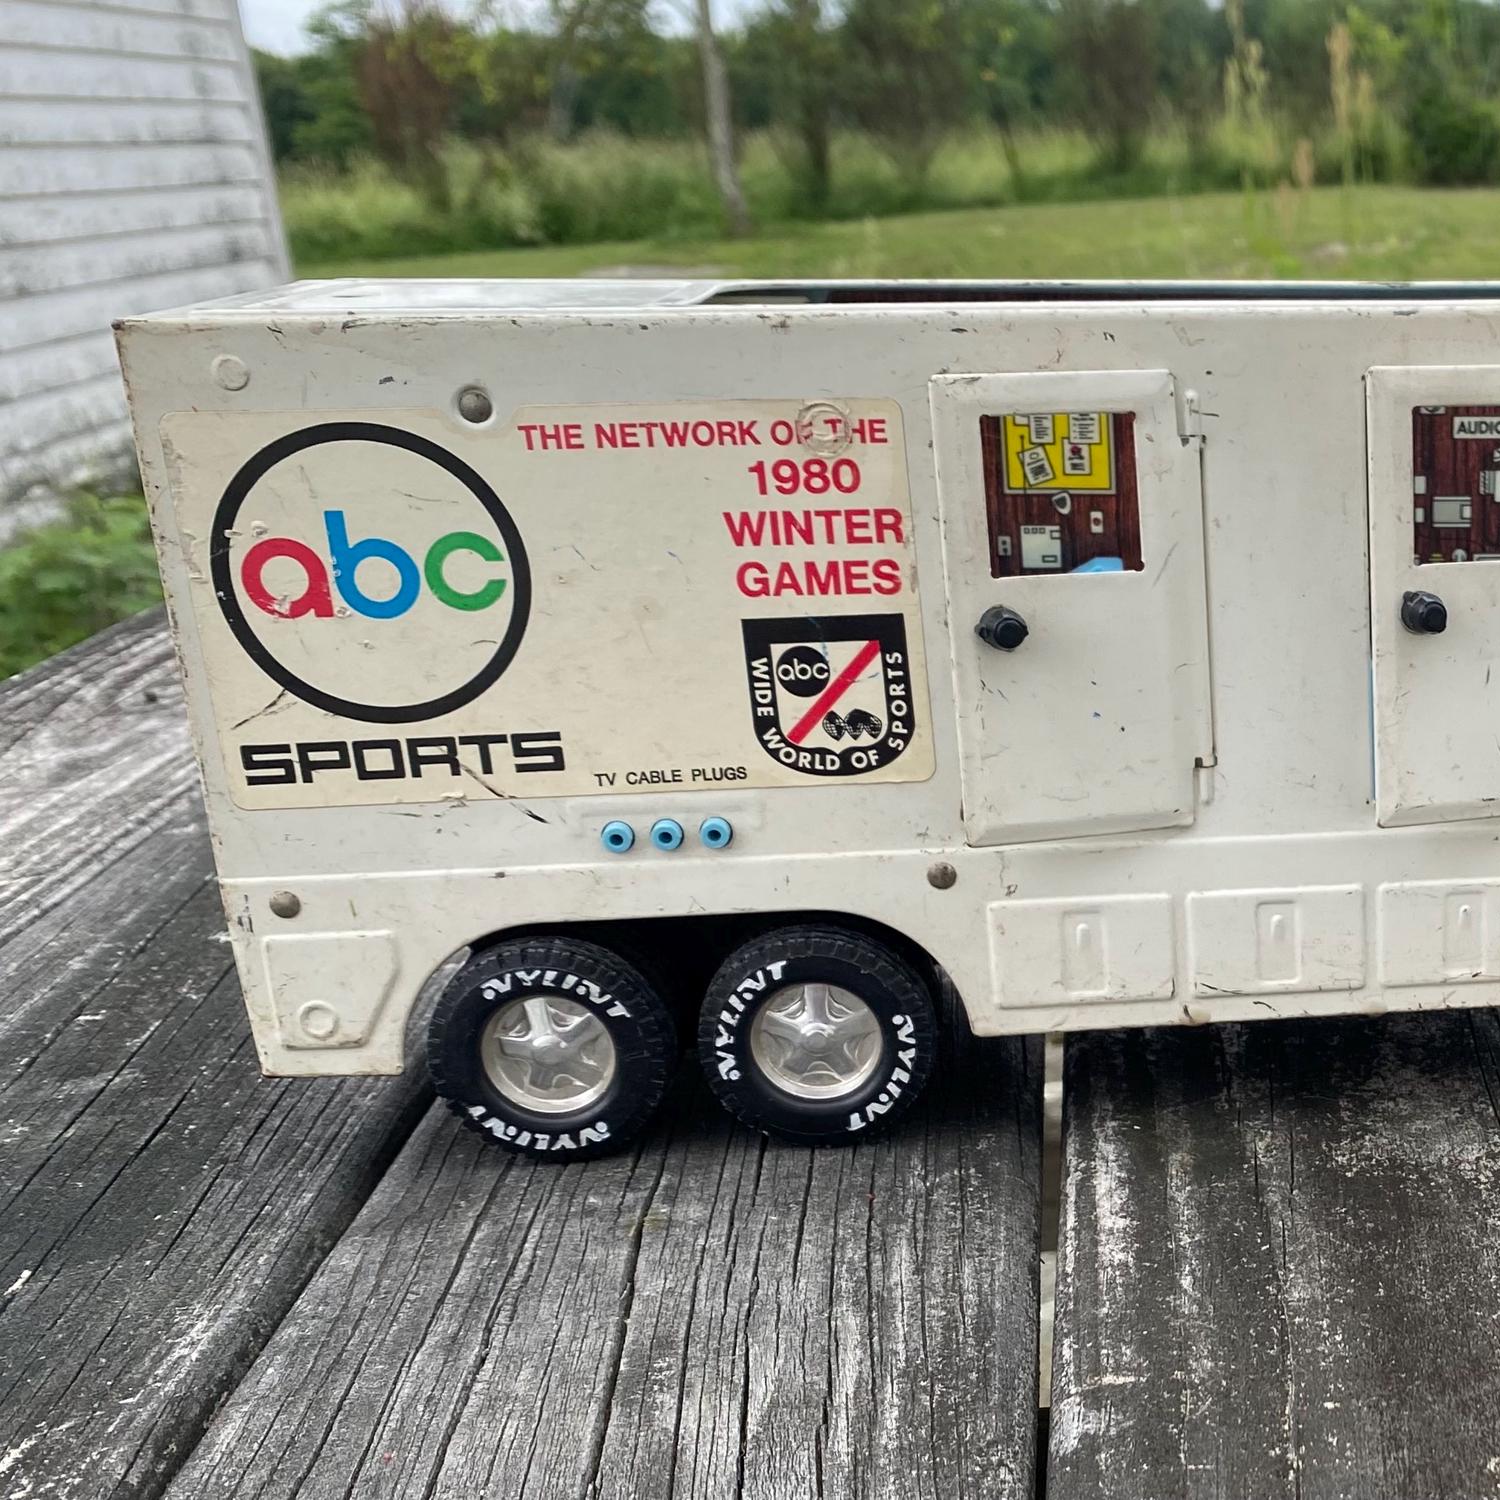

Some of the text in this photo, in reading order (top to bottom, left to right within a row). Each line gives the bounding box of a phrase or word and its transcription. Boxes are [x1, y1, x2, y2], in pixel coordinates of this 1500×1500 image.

[517, 418, 888, 451] THE NETWORK OF THE
[748, 458, 862, 495] 1980
[722, 507, 904, 547] WINTER
[240, 510, 508, 620] abc
[735, 558, 902, 598] GAMES
[777, 658, 829, 682] abc
[750, 651, 909, 771] WIDE WORLD OF SPORTS
[239, 731, 566, 787] SPORTS
[593, 765, 748, 788] TV CABLE PLUGS
[480, 969, 633, 1019] NYLINT
[715, 960, 787, 1081] NYLINT
[845, 1014, 917, 1131] NYLINT
